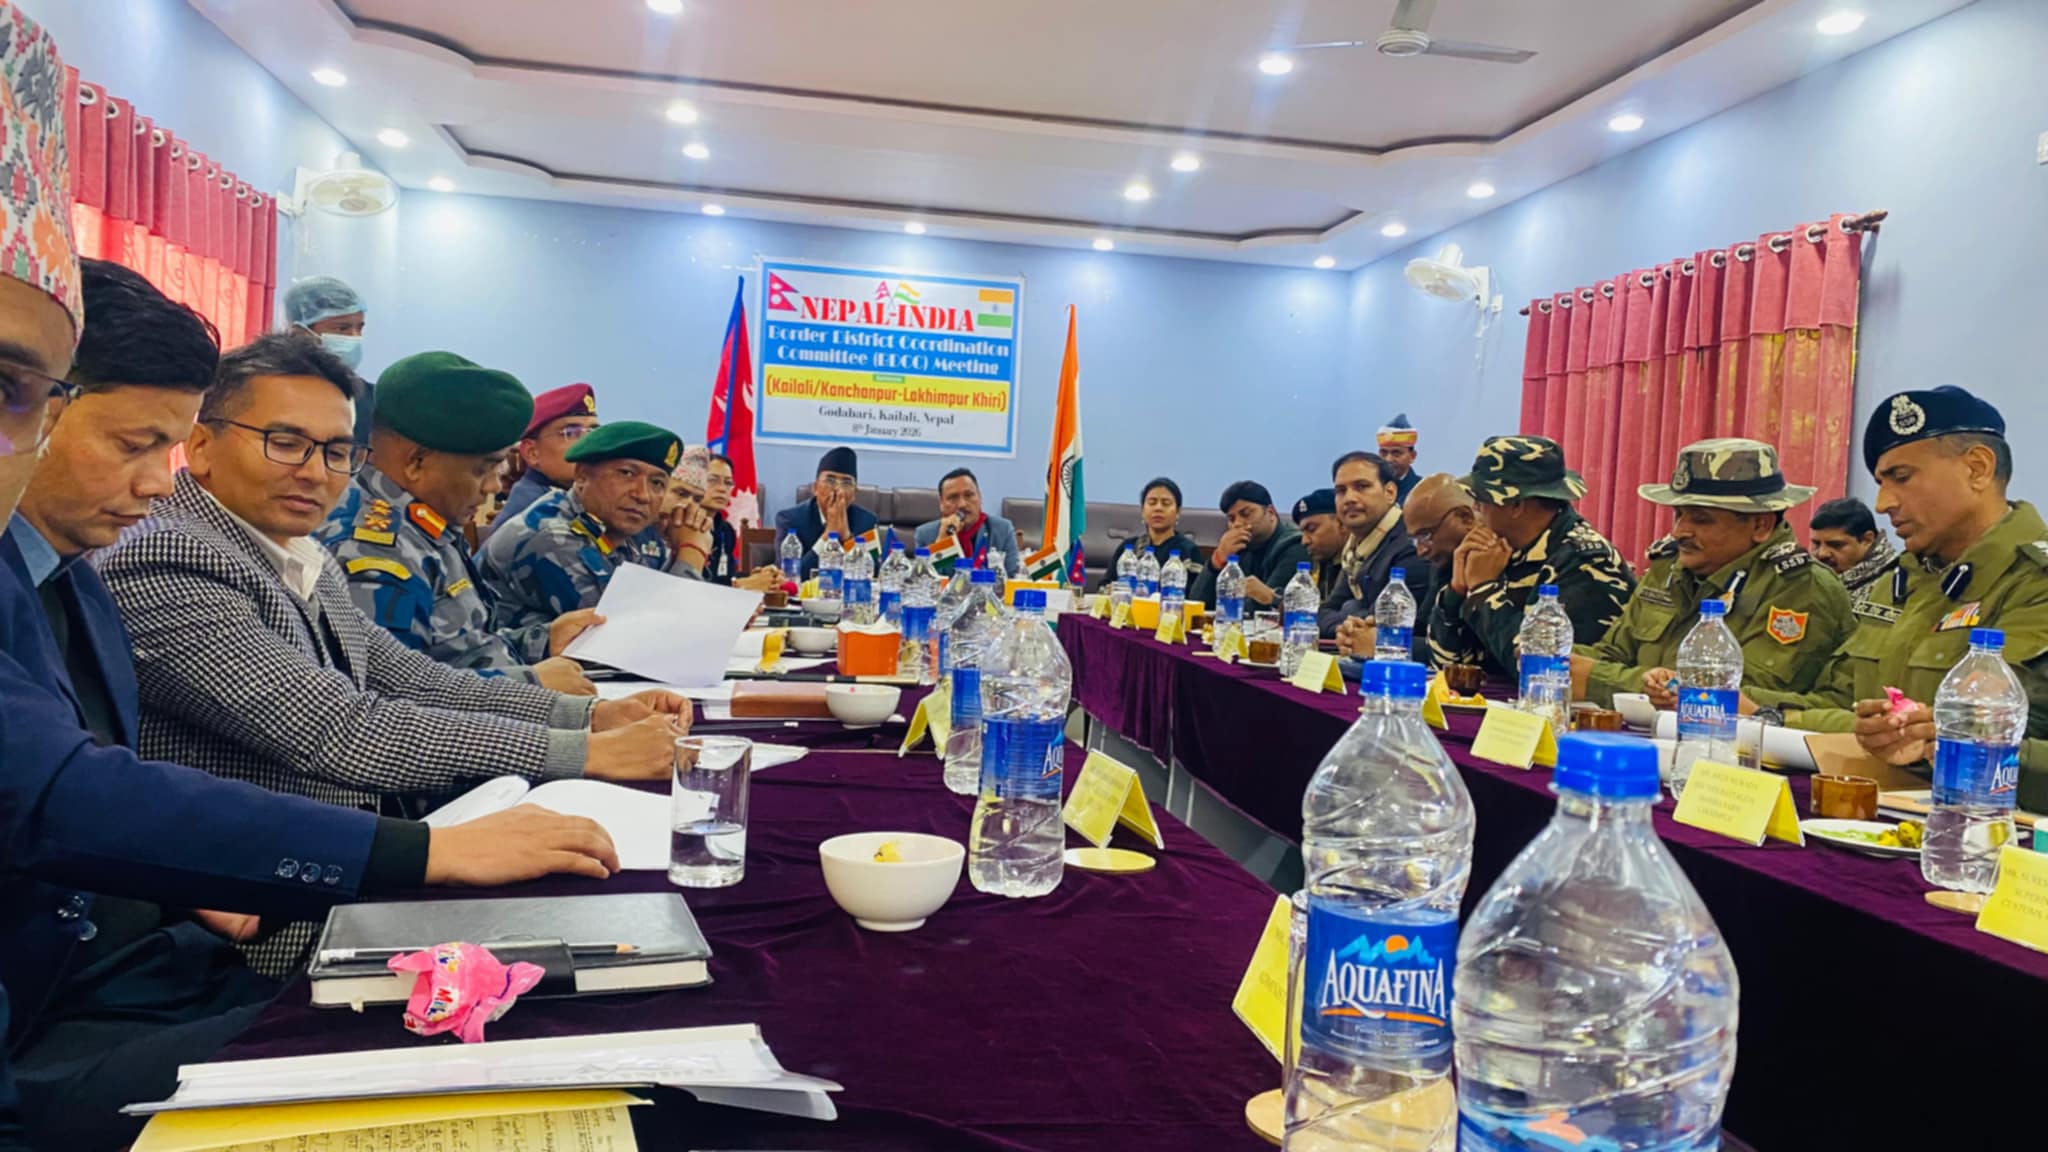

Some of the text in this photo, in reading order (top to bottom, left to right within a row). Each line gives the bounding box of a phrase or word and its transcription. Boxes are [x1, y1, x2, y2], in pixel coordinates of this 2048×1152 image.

[800, 295, 975, 333] NEPAL-INDIA
[768, 325, 1009, 357] Border District Coordination
[777, 344, 999, 375] Committee (BDCC) Meeting
[766, 374, 1007, 412] (Kailali/Kanchanpur-Lakhimpur Khiri)
[864, 424, 898, 437] January
[924, 412, 955, 427] Nepal
[1320, 947, 1447, 1020] AQUAFINA
